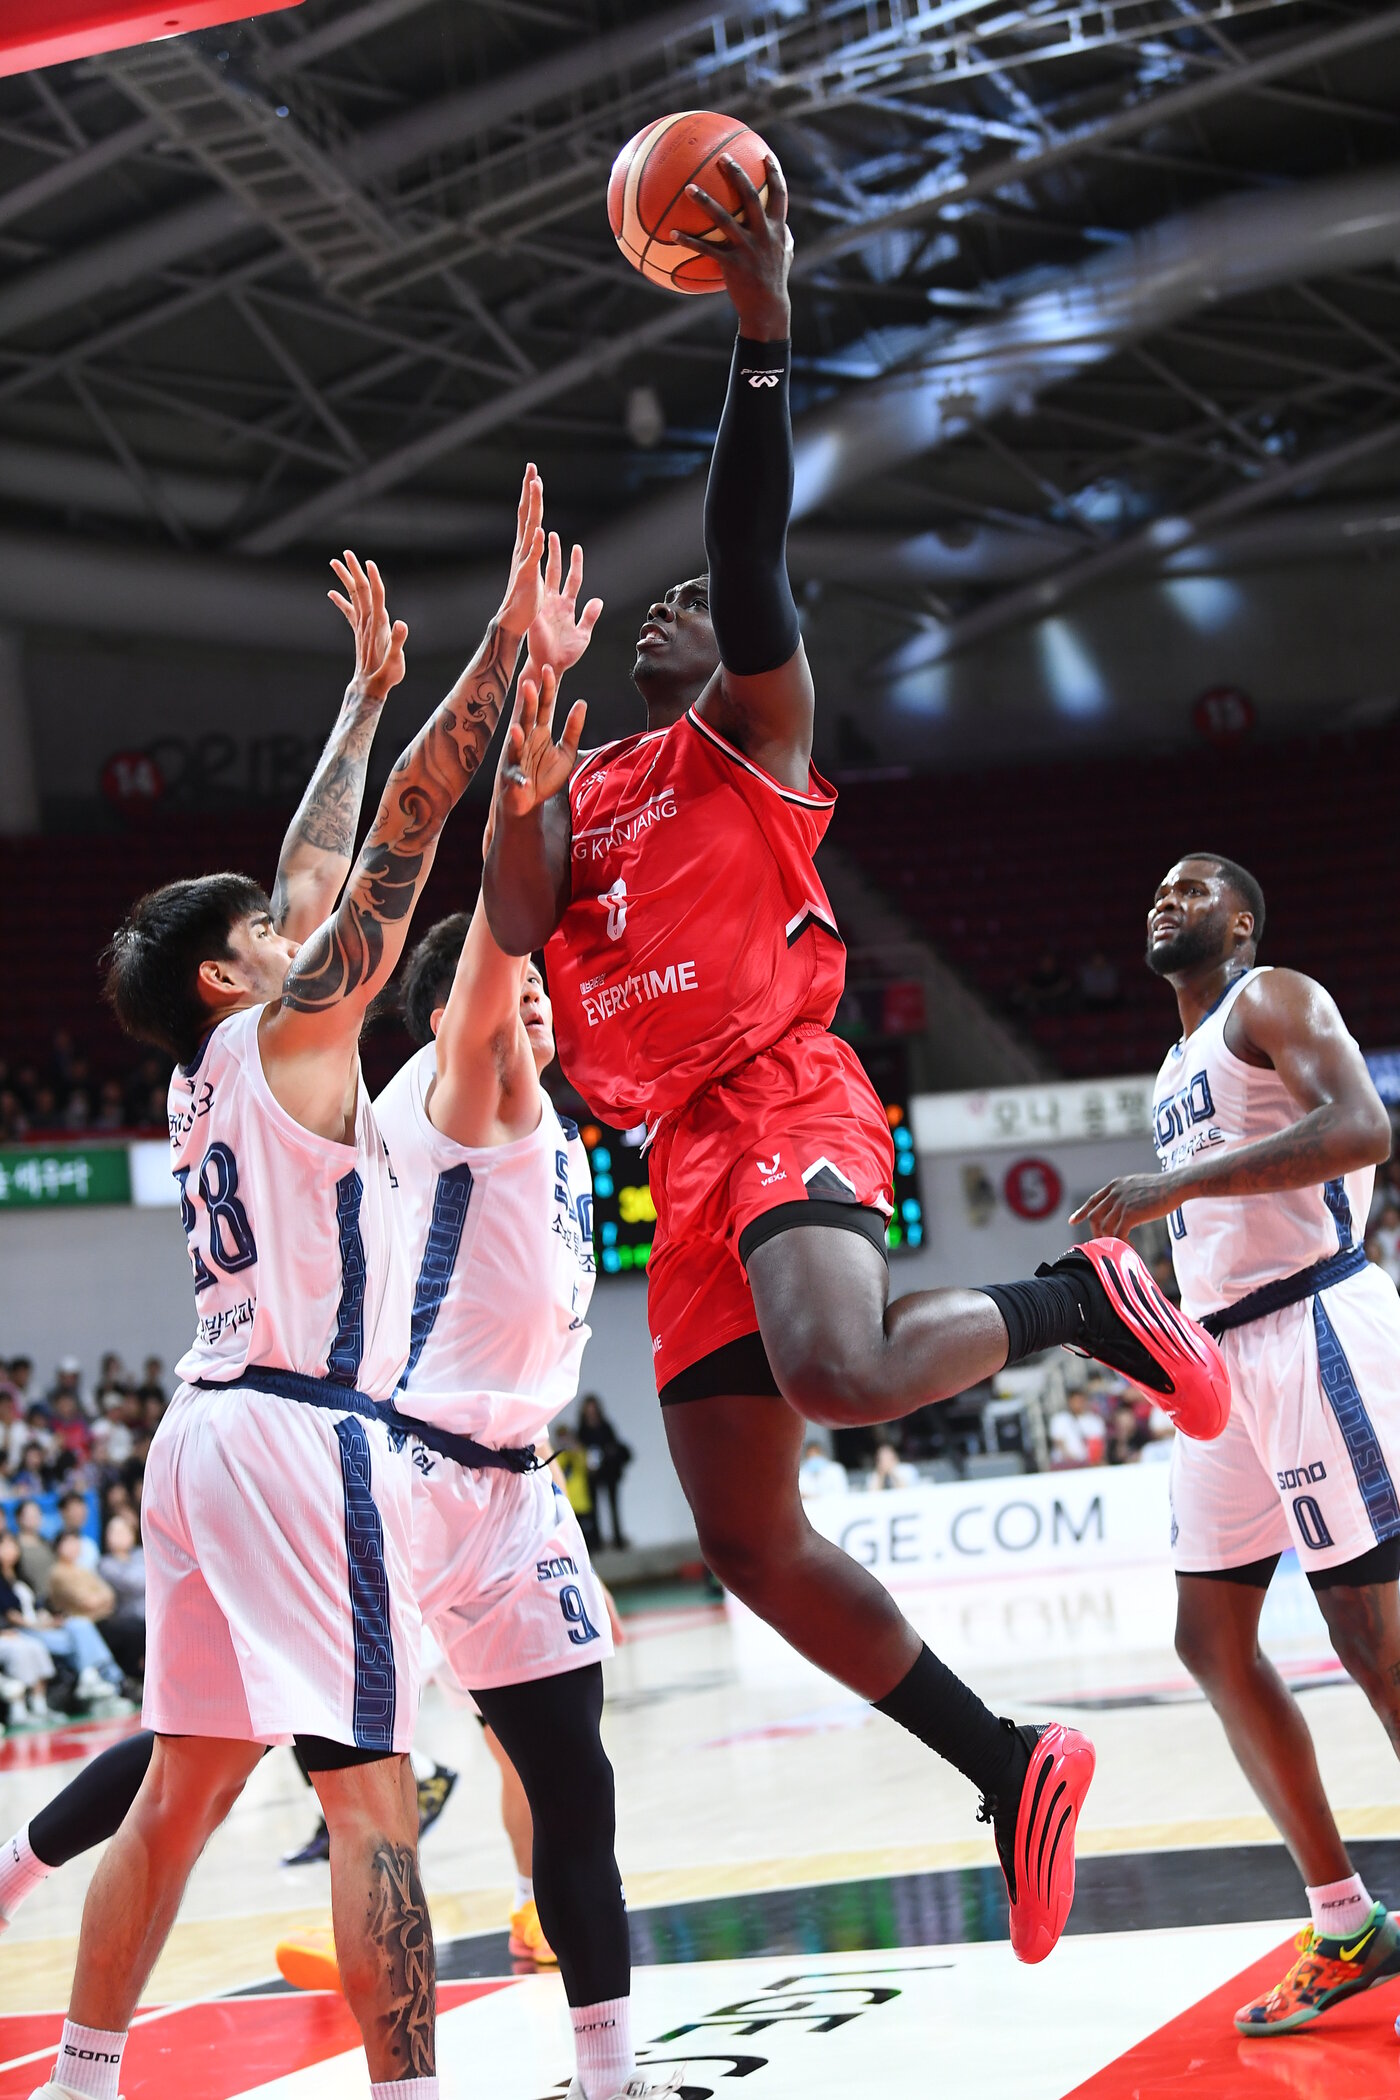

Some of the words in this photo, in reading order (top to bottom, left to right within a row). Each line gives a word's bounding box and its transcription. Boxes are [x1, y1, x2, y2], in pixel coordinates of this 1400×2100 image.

[581, 960, 699, 1027] EVERYTIME
[760, 1170, 787, 1187] VEXX
[1019, 1166, 1049, 1213] 5
[559, 1585, 600, 1645] 9
